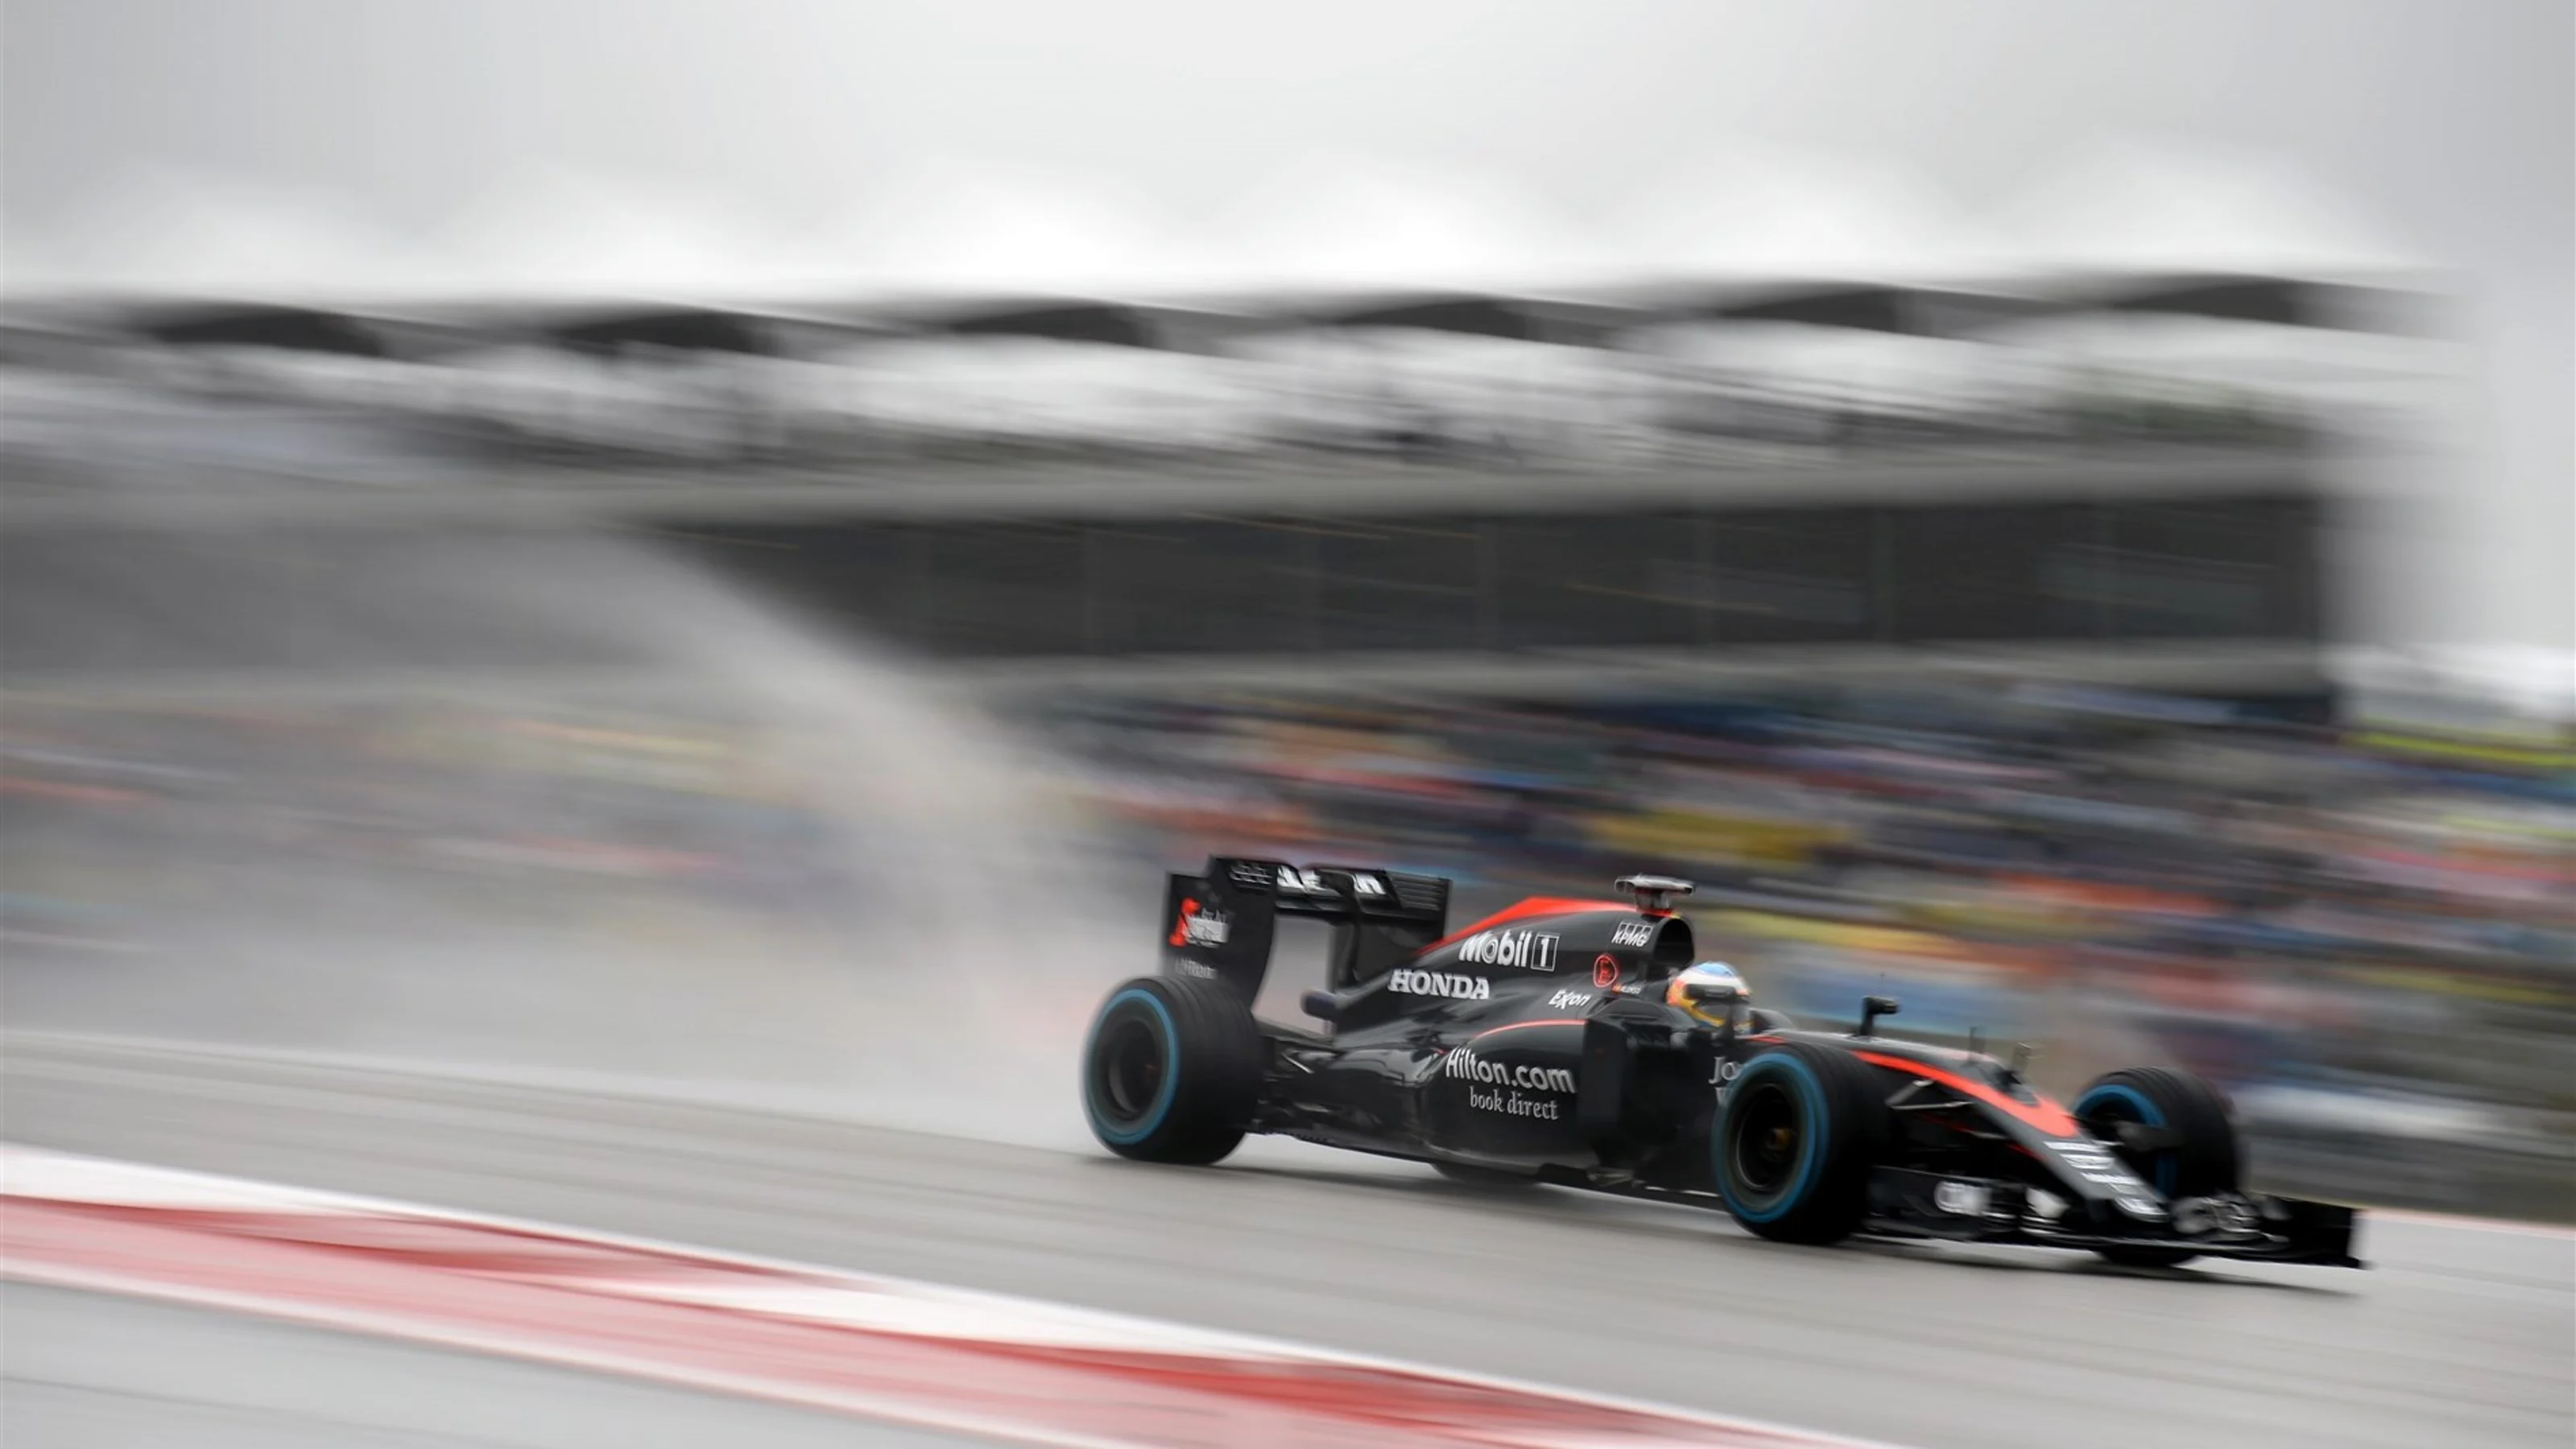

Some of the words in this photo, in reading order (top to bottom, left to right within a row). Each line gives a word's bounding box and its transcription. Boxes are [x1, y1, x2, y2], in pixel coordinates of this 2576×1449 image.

[1458, 929, 1532, 967] Mobil
[1611, 930, 1648, 947] KPMG
[1387, 968, 1490, 1000] HONDA
[1445, 1047, 1577, 1093] Hilton.com
[1470, 1087, 1503, 1112] book
[1507, 1090, 1558, 1120] direct
